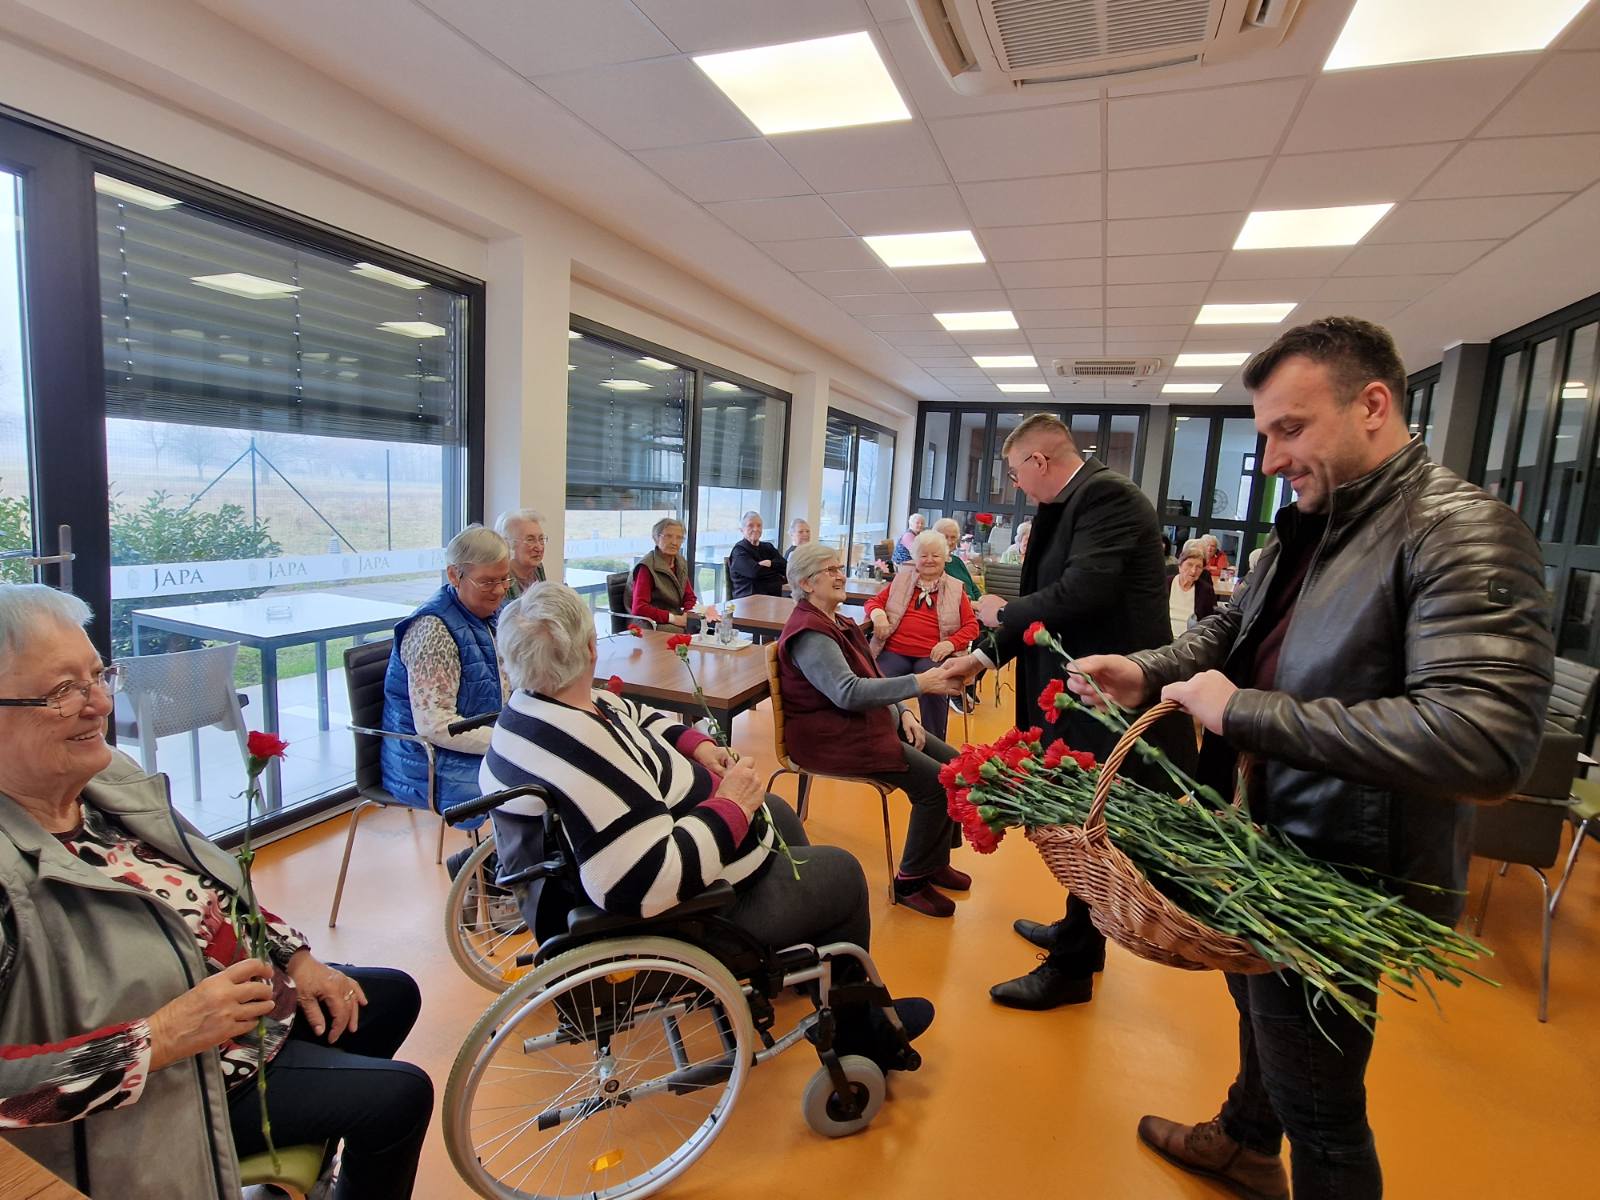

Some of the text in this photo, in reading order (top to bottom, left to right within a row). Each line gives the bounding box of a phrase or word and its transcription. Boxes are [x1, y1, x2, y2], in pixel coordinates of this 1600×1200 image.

[153, 568, 204, 592] JAPA
[267, 561, 308, 582] JAPA
[358, 555, 390, 573] JAPA
